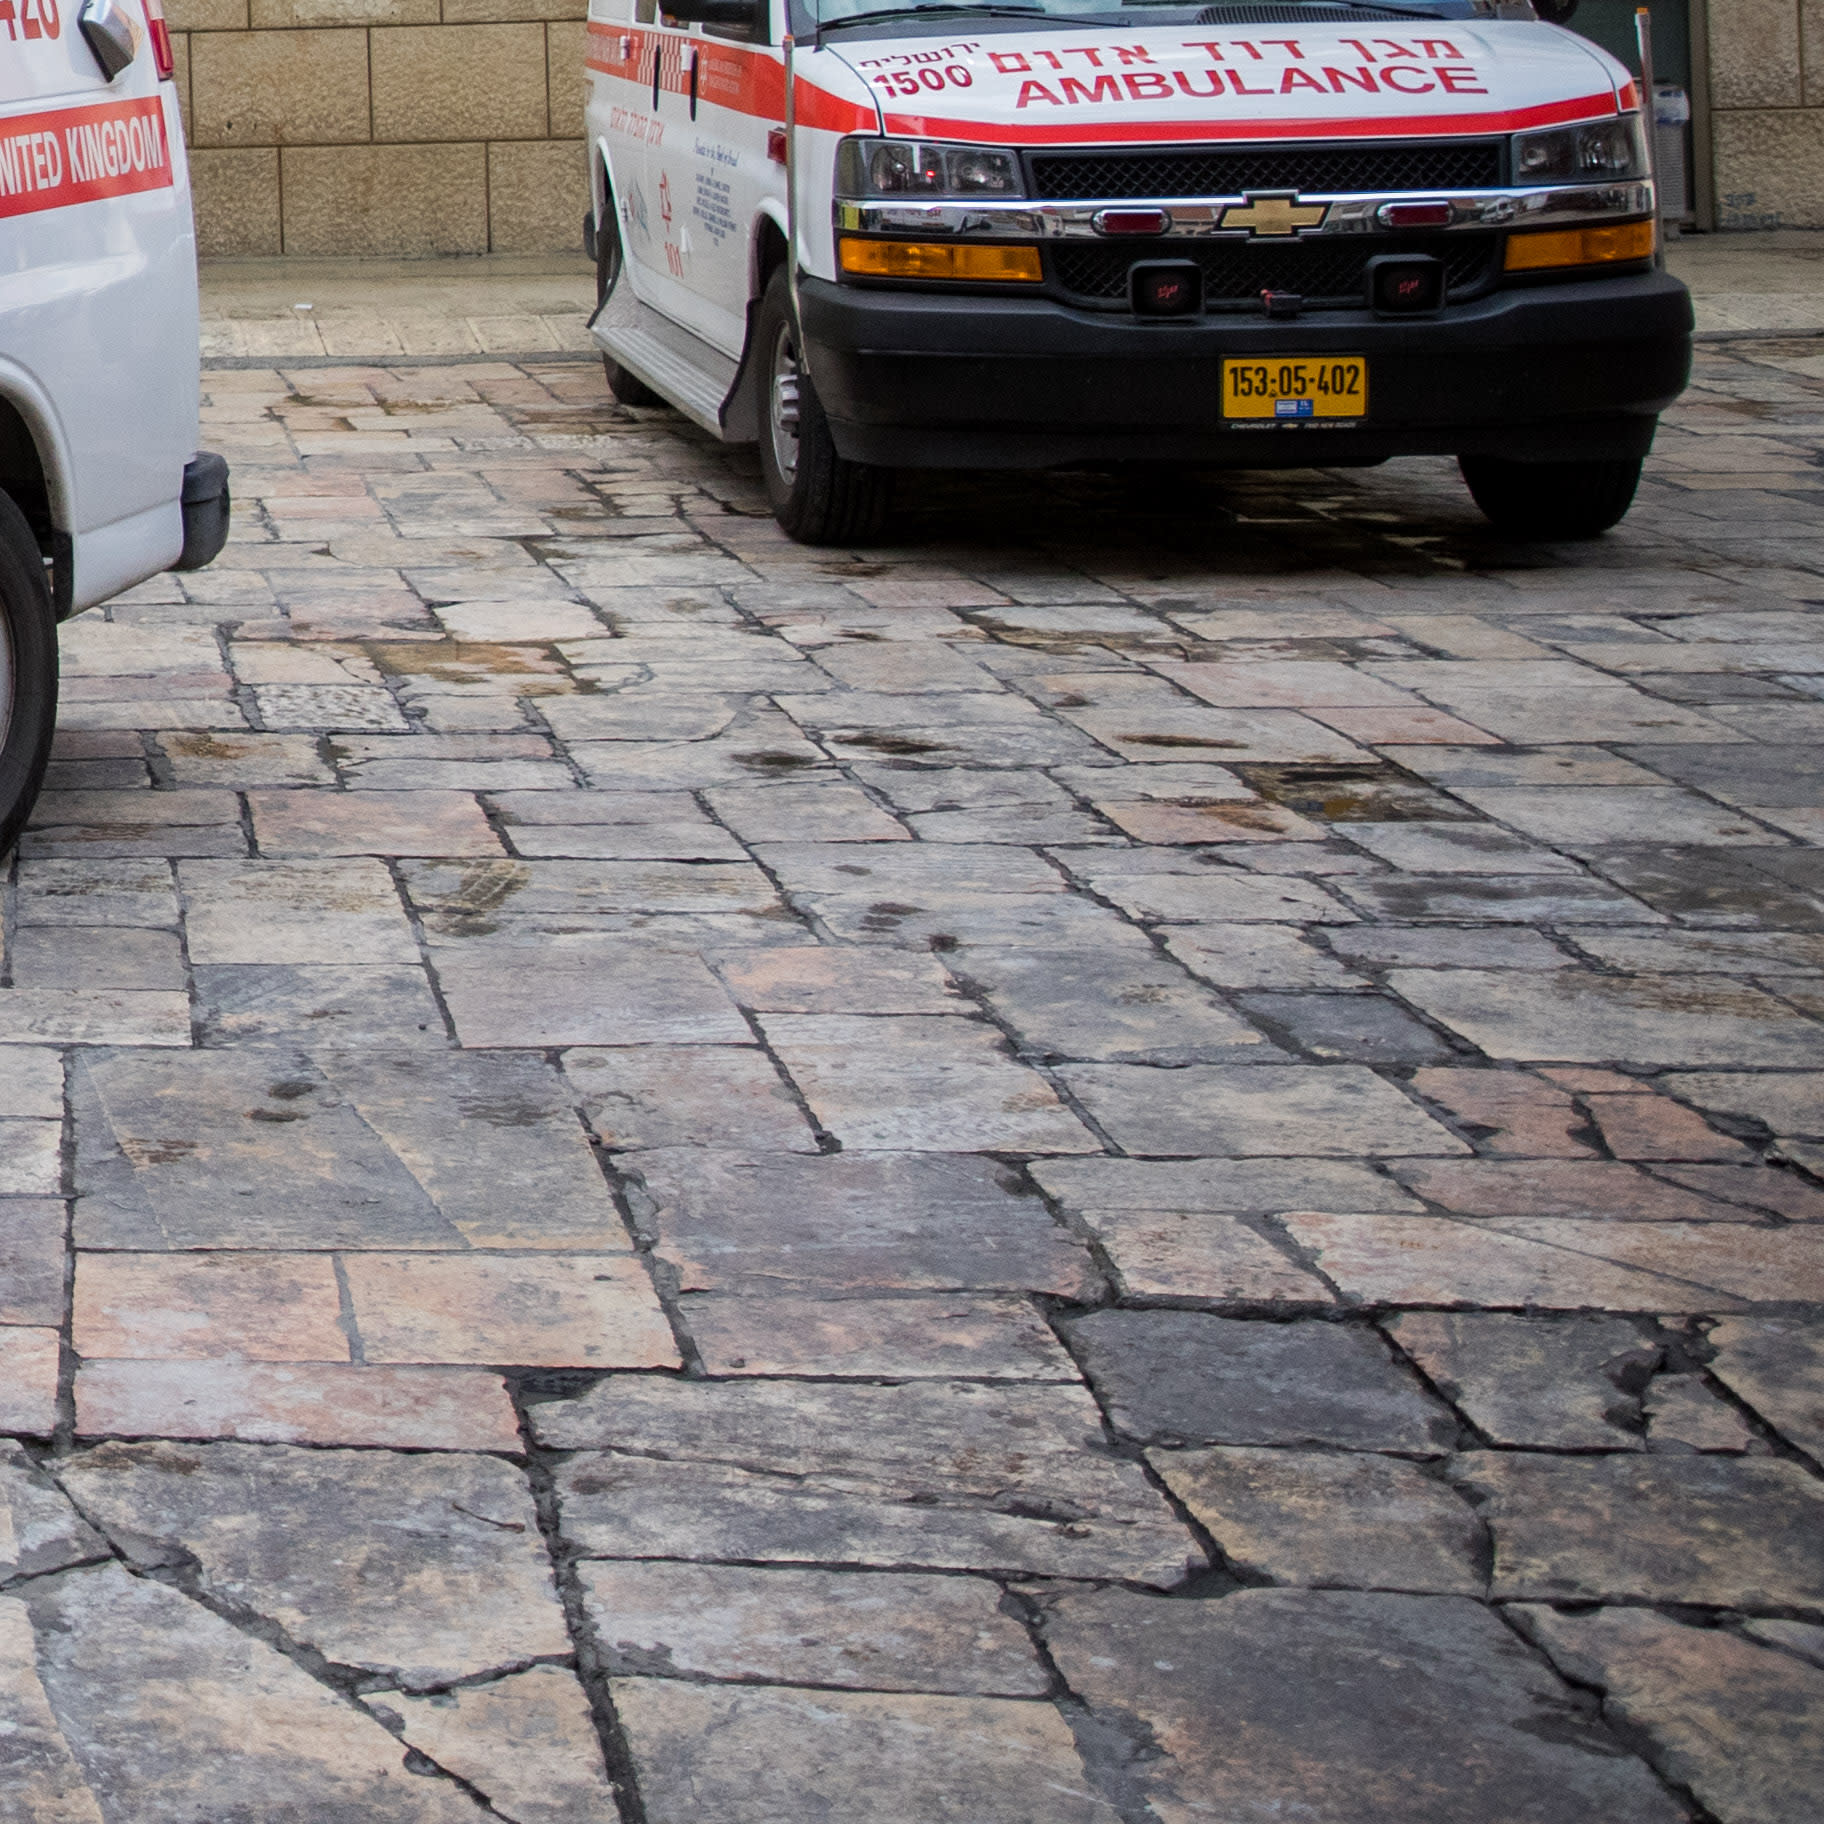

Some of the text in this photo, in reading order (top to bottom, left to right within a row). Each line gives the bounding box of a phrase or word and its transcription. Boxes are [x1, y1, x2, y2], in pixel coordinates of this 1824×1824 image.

[859, 42, 980, 69] ירושלים
[987, 39, 1465, 74] מגן דוד אדום
[873, 64, 973, 99] 1500
[1016, 66, 1489, 109] AMBULANCE
[65, 114, 164, 184] KINGDOM
